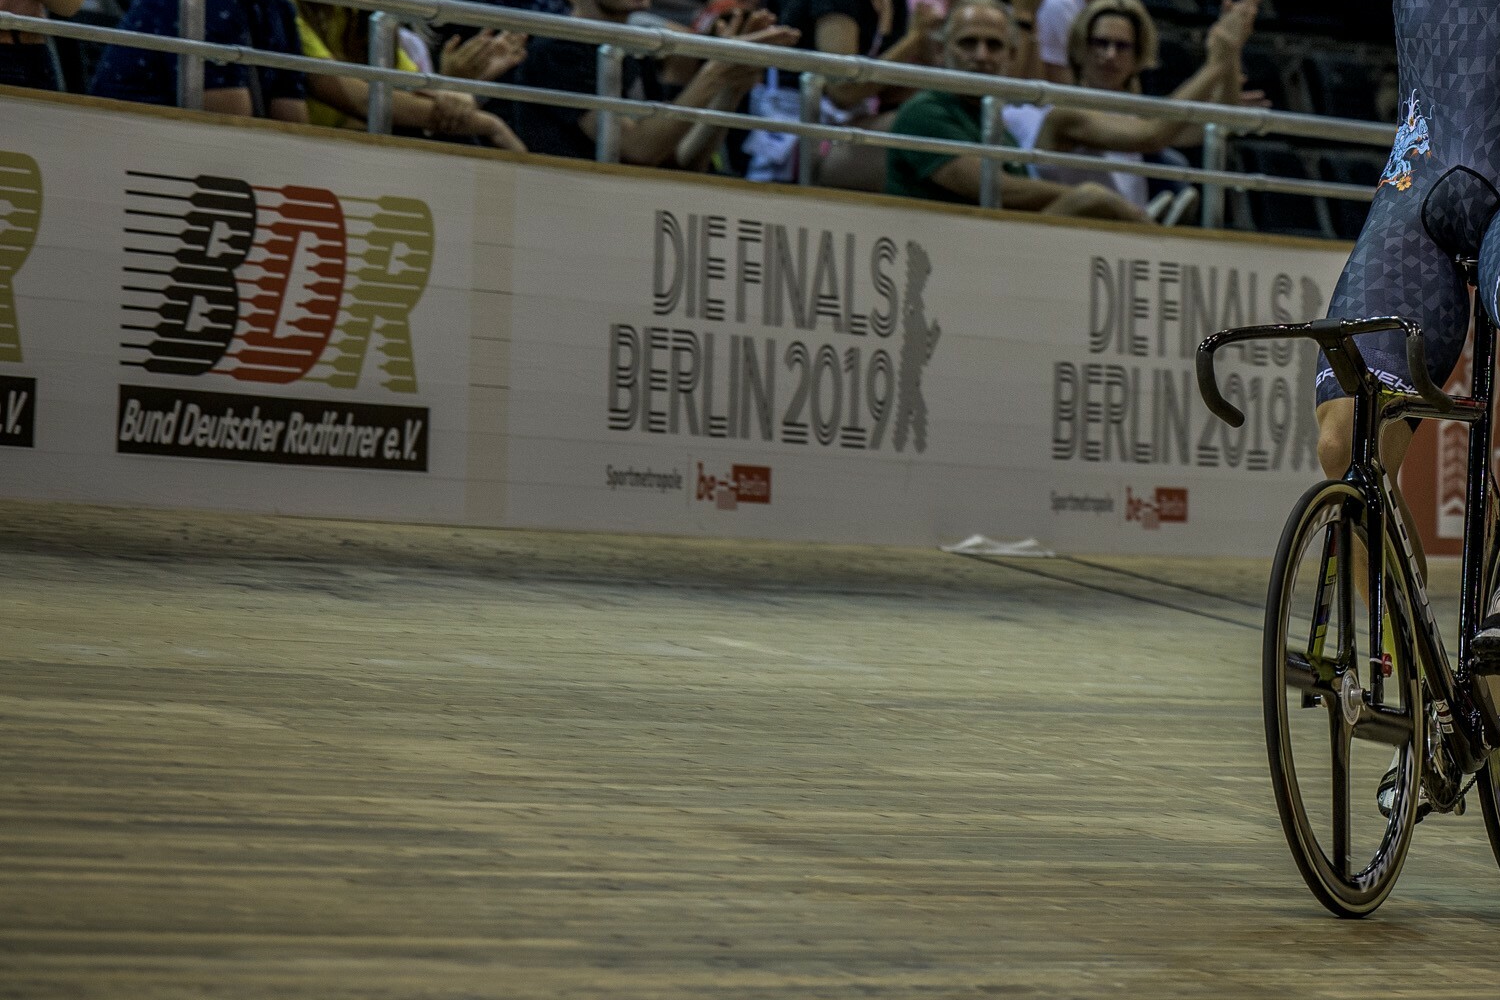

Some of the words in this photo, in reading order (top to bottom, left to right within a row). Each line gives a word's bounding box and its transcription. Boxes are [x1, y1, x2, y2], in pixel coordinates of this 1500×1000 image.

[120, 170, 435, 394] BDR
[653, 209, 727, 322] DIE
[736, 218, 898, 339] FINALS
[1089, 255, 1150, 358] DIE
[1158, 261, 1295, 367] FINALS
[0, 391, 28, 435] .V.
[119, 398, 180, 443] Bund
[178, 403, 283, 452] Deutscher
[283, 410, 384, 458] Radfahrer
[384, 419, 423, 461] e.V.
[607, 323, 776, 442] BERLIN
[781, 340, 896, 451] 2019
[1051, 360, 1192, 467] BERLIN
[605, 464, 684, 494] Sportmetropole
